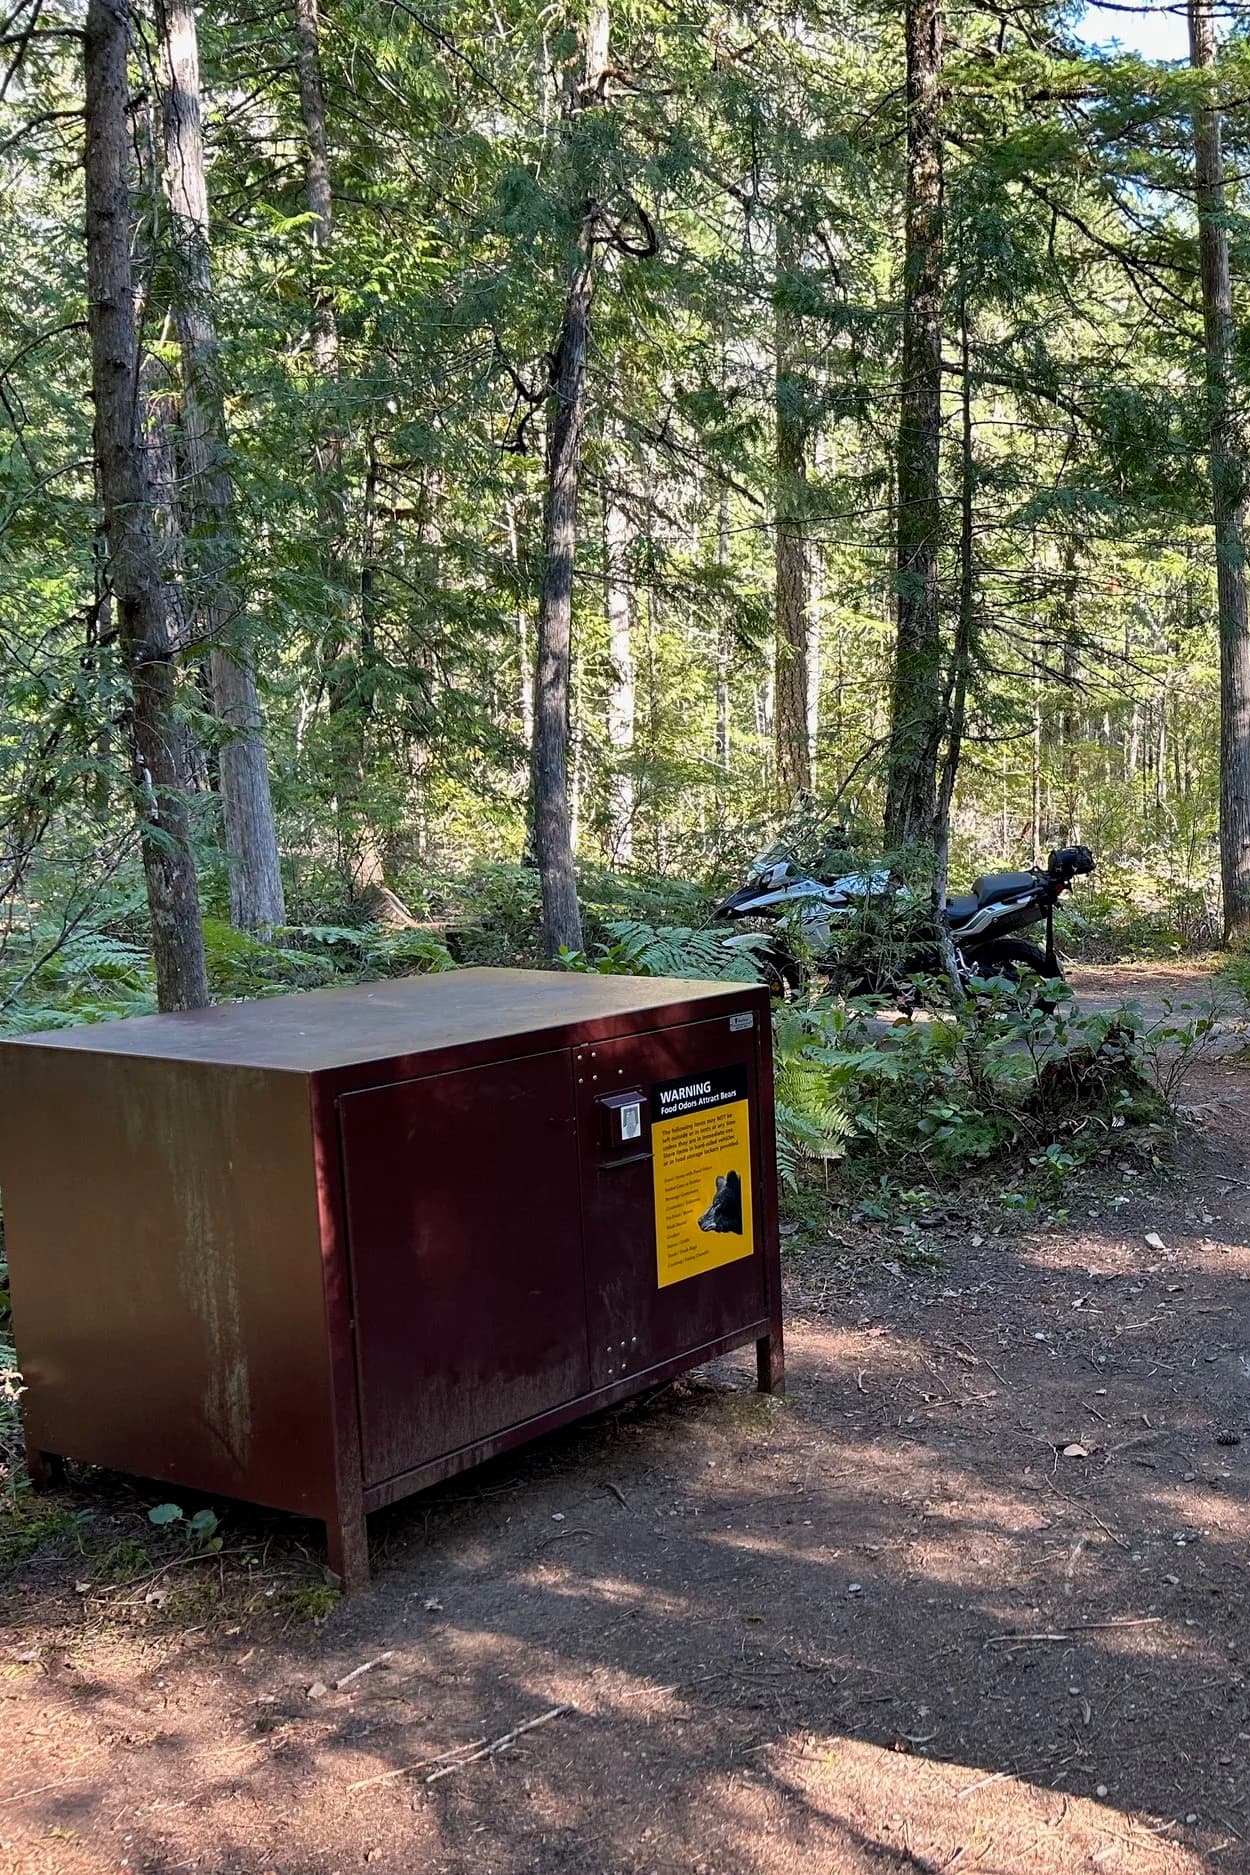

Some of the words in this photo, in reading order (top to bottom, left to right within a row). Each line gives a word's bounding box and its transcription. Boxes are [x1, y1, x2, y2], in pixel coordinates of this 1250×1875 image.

[660, 1081, 711, 1104] WARNING
[661, 1104, 677, 1115] Food
[678, 1101, 697, 1111] Odors
[698, 1094, 719, 1106] Attract
[720, 1090, 737, 1101] Bears
